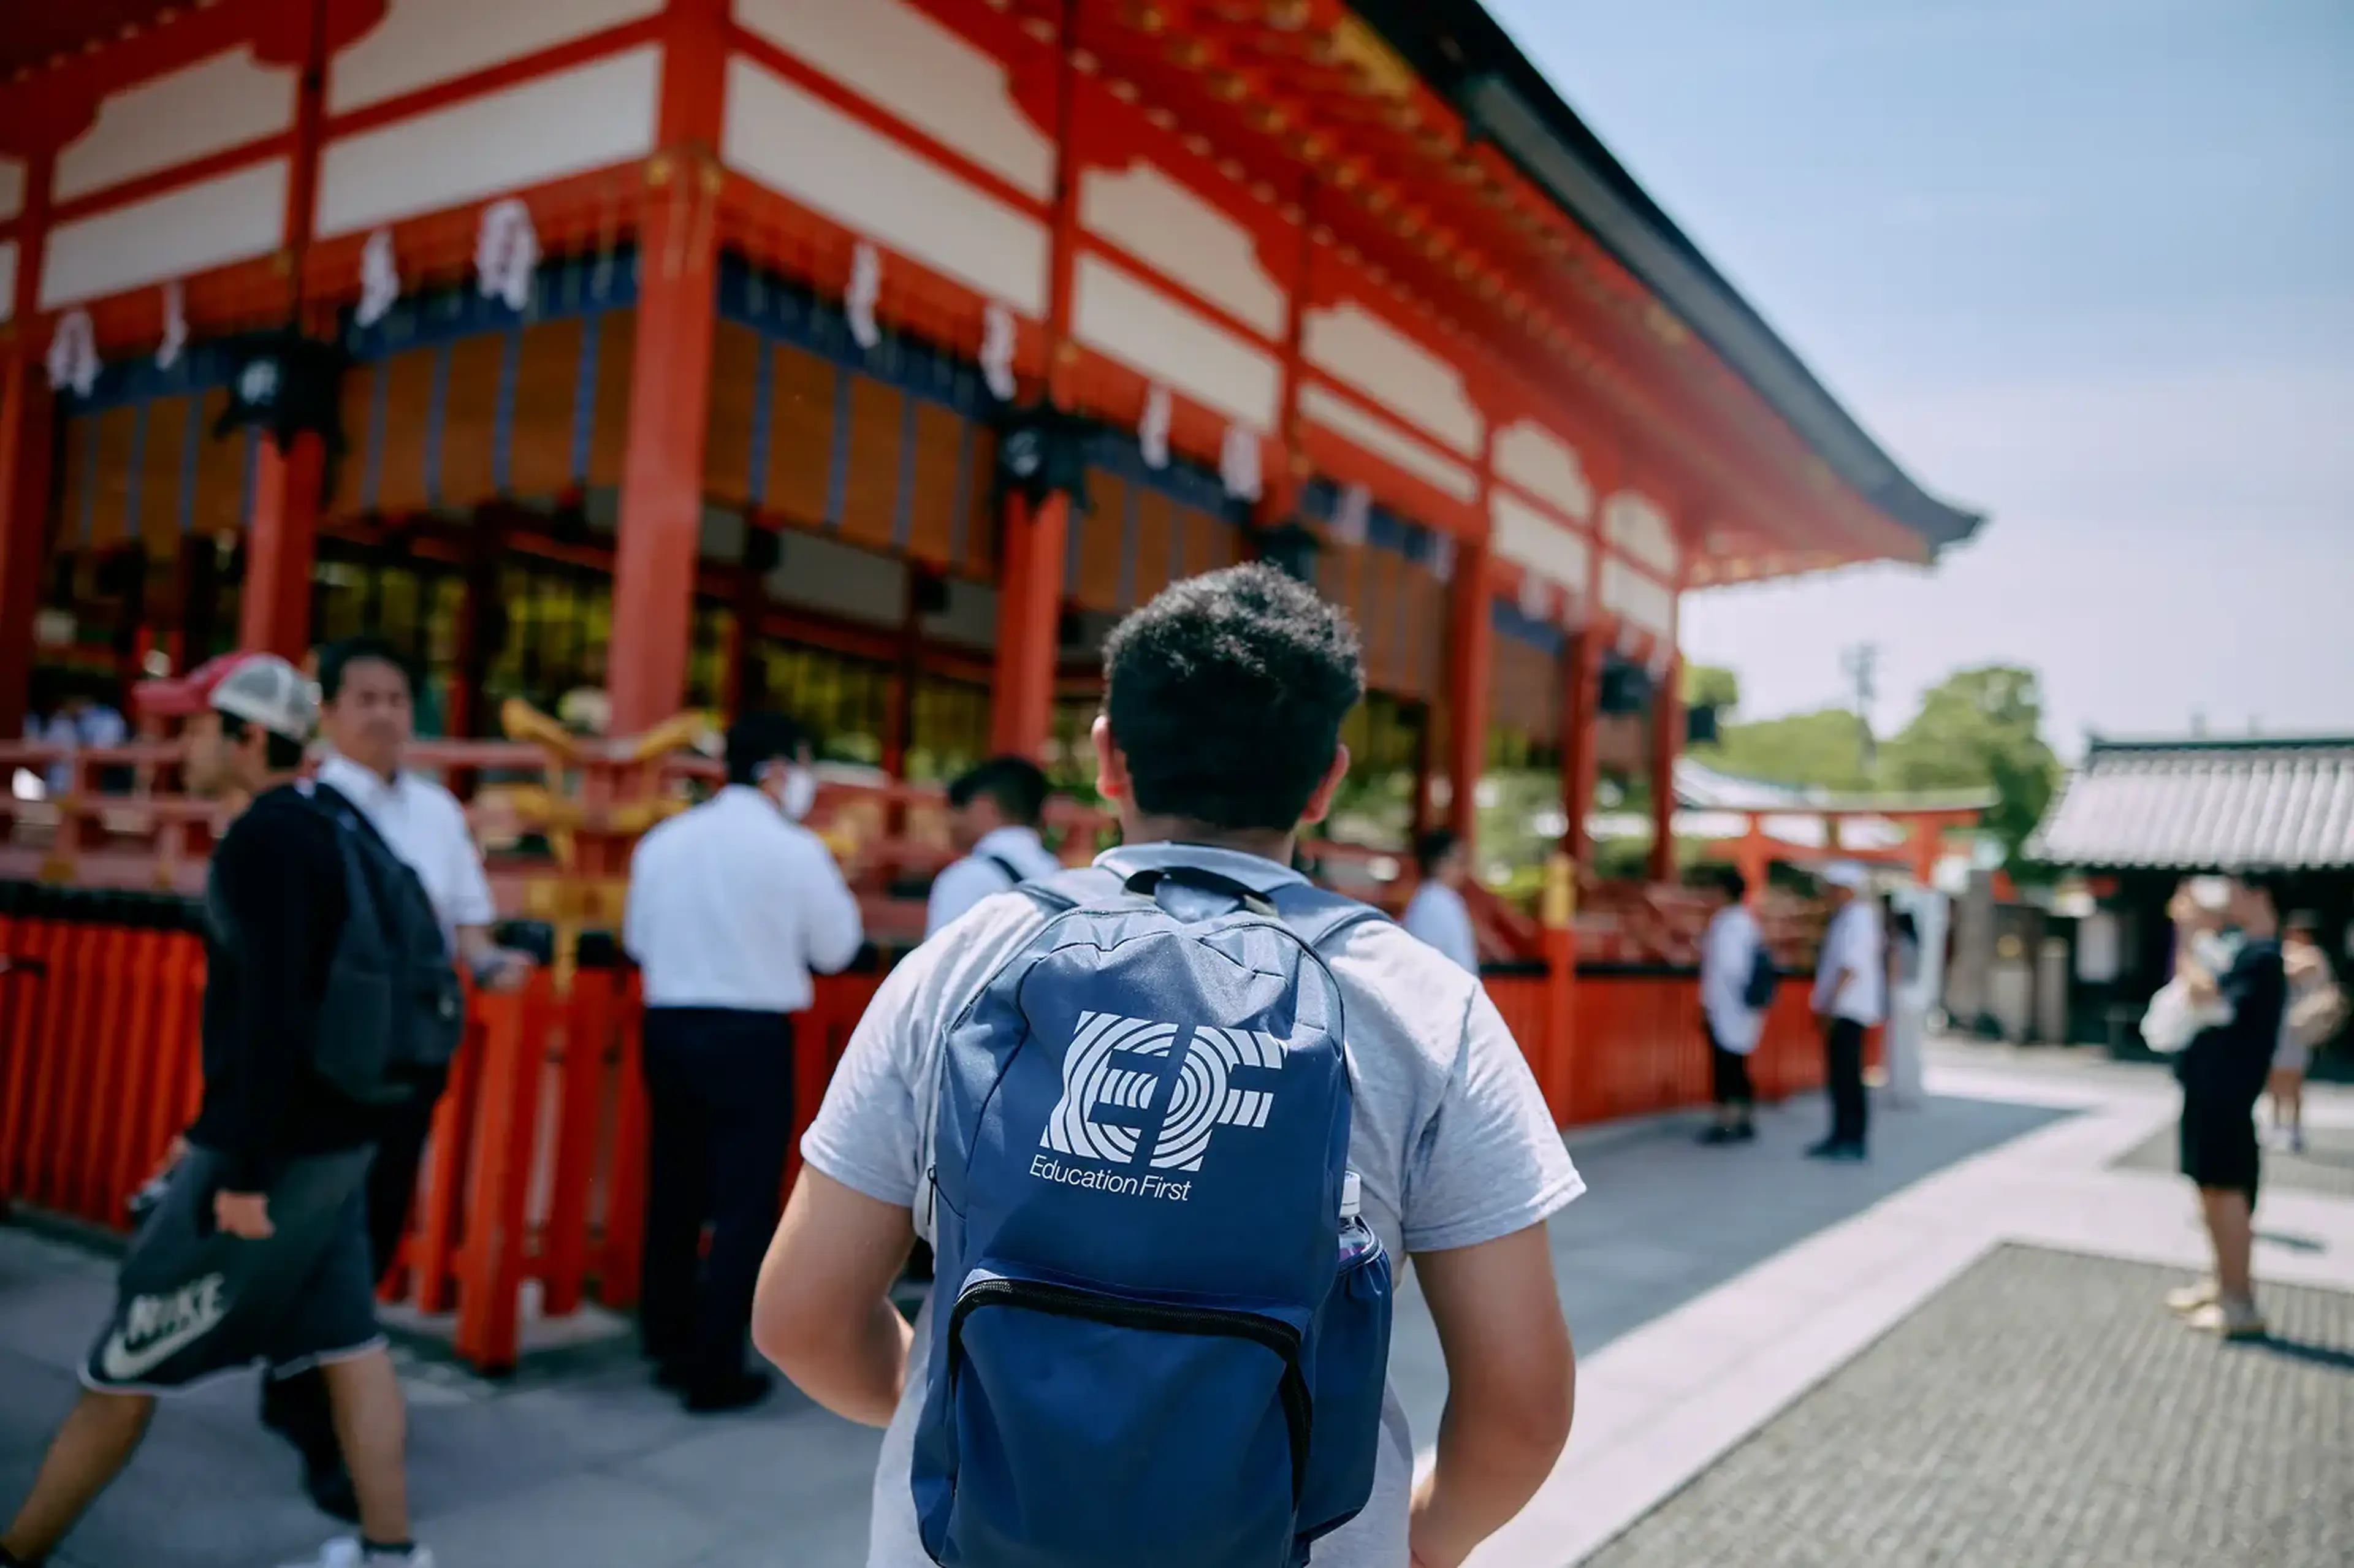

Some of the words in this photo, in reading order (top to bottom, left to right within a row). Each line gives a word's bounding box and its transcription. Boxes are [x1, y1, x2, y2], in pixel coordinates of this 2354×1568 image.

[1040, 1010, 1288, 1172] EF
[1029, 1154, 1138, 1195] Education
[1139, 1174, 1192, 1201] First
[125, 1271, 226, 1344] NIKE
